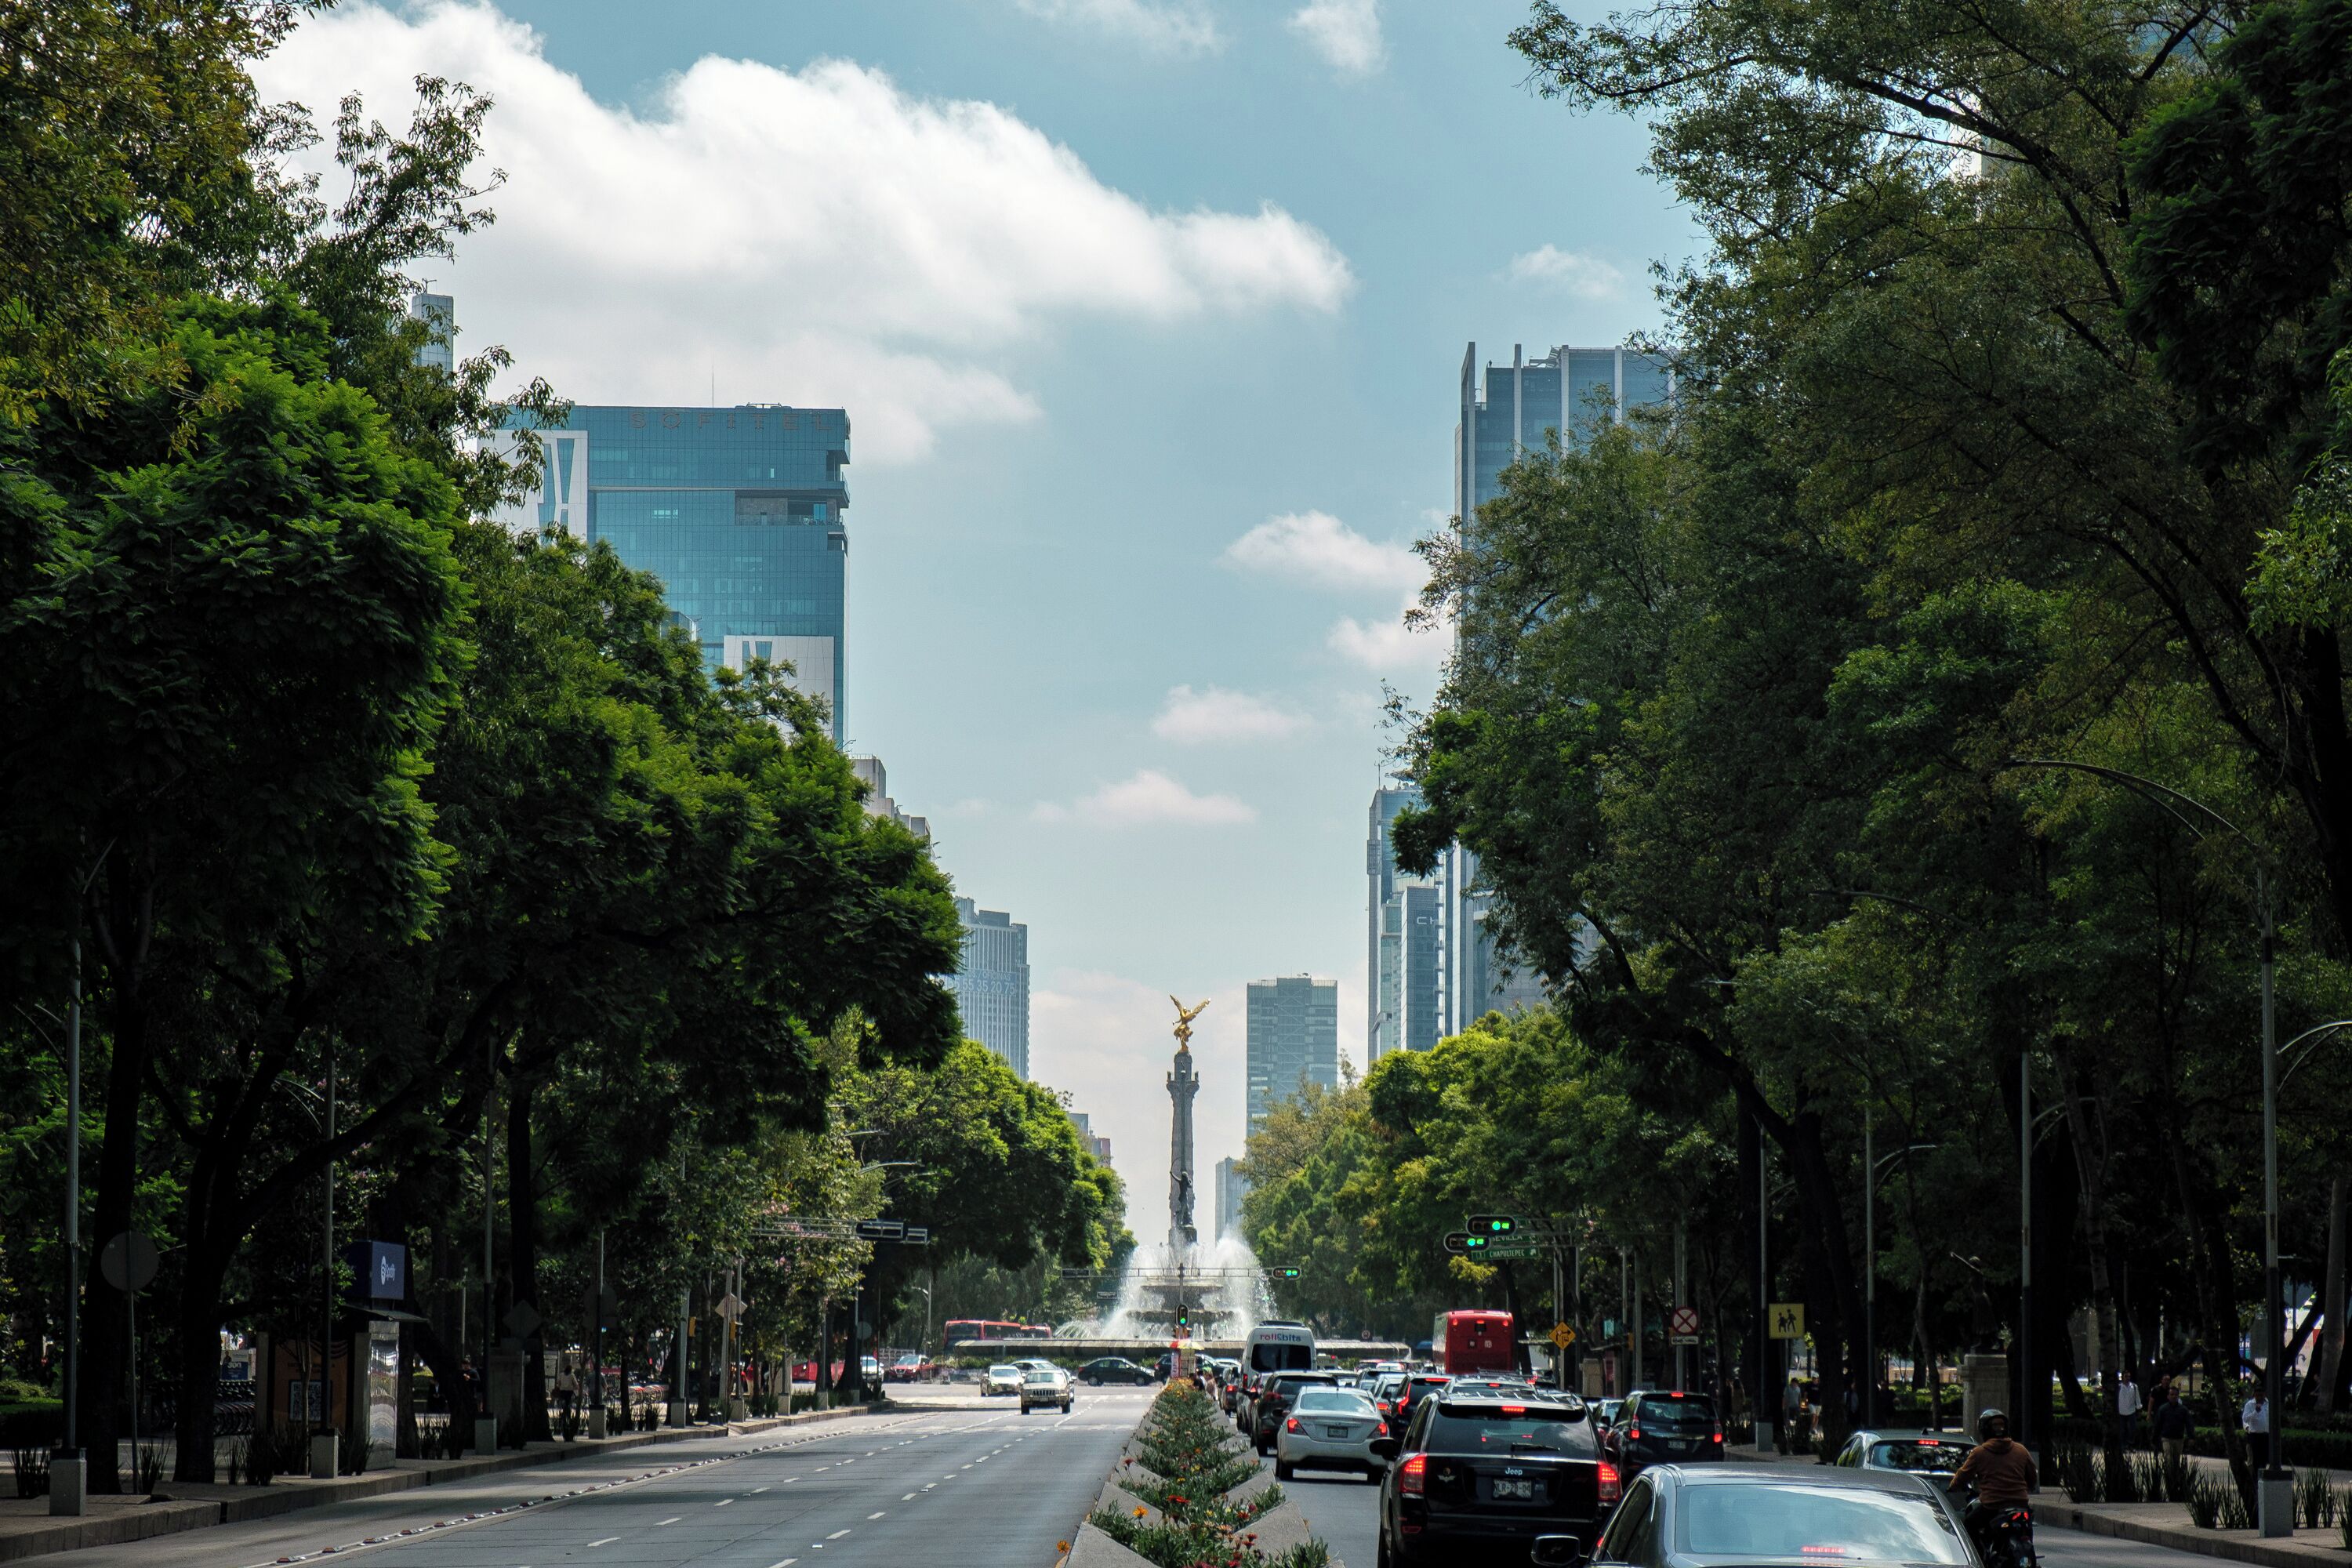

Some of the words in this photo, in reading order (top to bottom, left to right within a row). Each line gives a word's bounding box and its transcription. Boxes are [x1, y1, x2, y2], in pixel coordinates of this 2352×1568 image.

[630, 412, 833, 431] SOFITEL
[982, 971, 1011, 982] OFICINAS
[963, 978, 974, 991] 55
[977, 980, 989, 992] 35
[990, 981, 1002, 993] 20
[1004, 982, 1015, 996] 75
[1490, 1248, 1525, 1258] CHAPULTEPEC
[1505, 1467, 1523, 1476] Jeep
